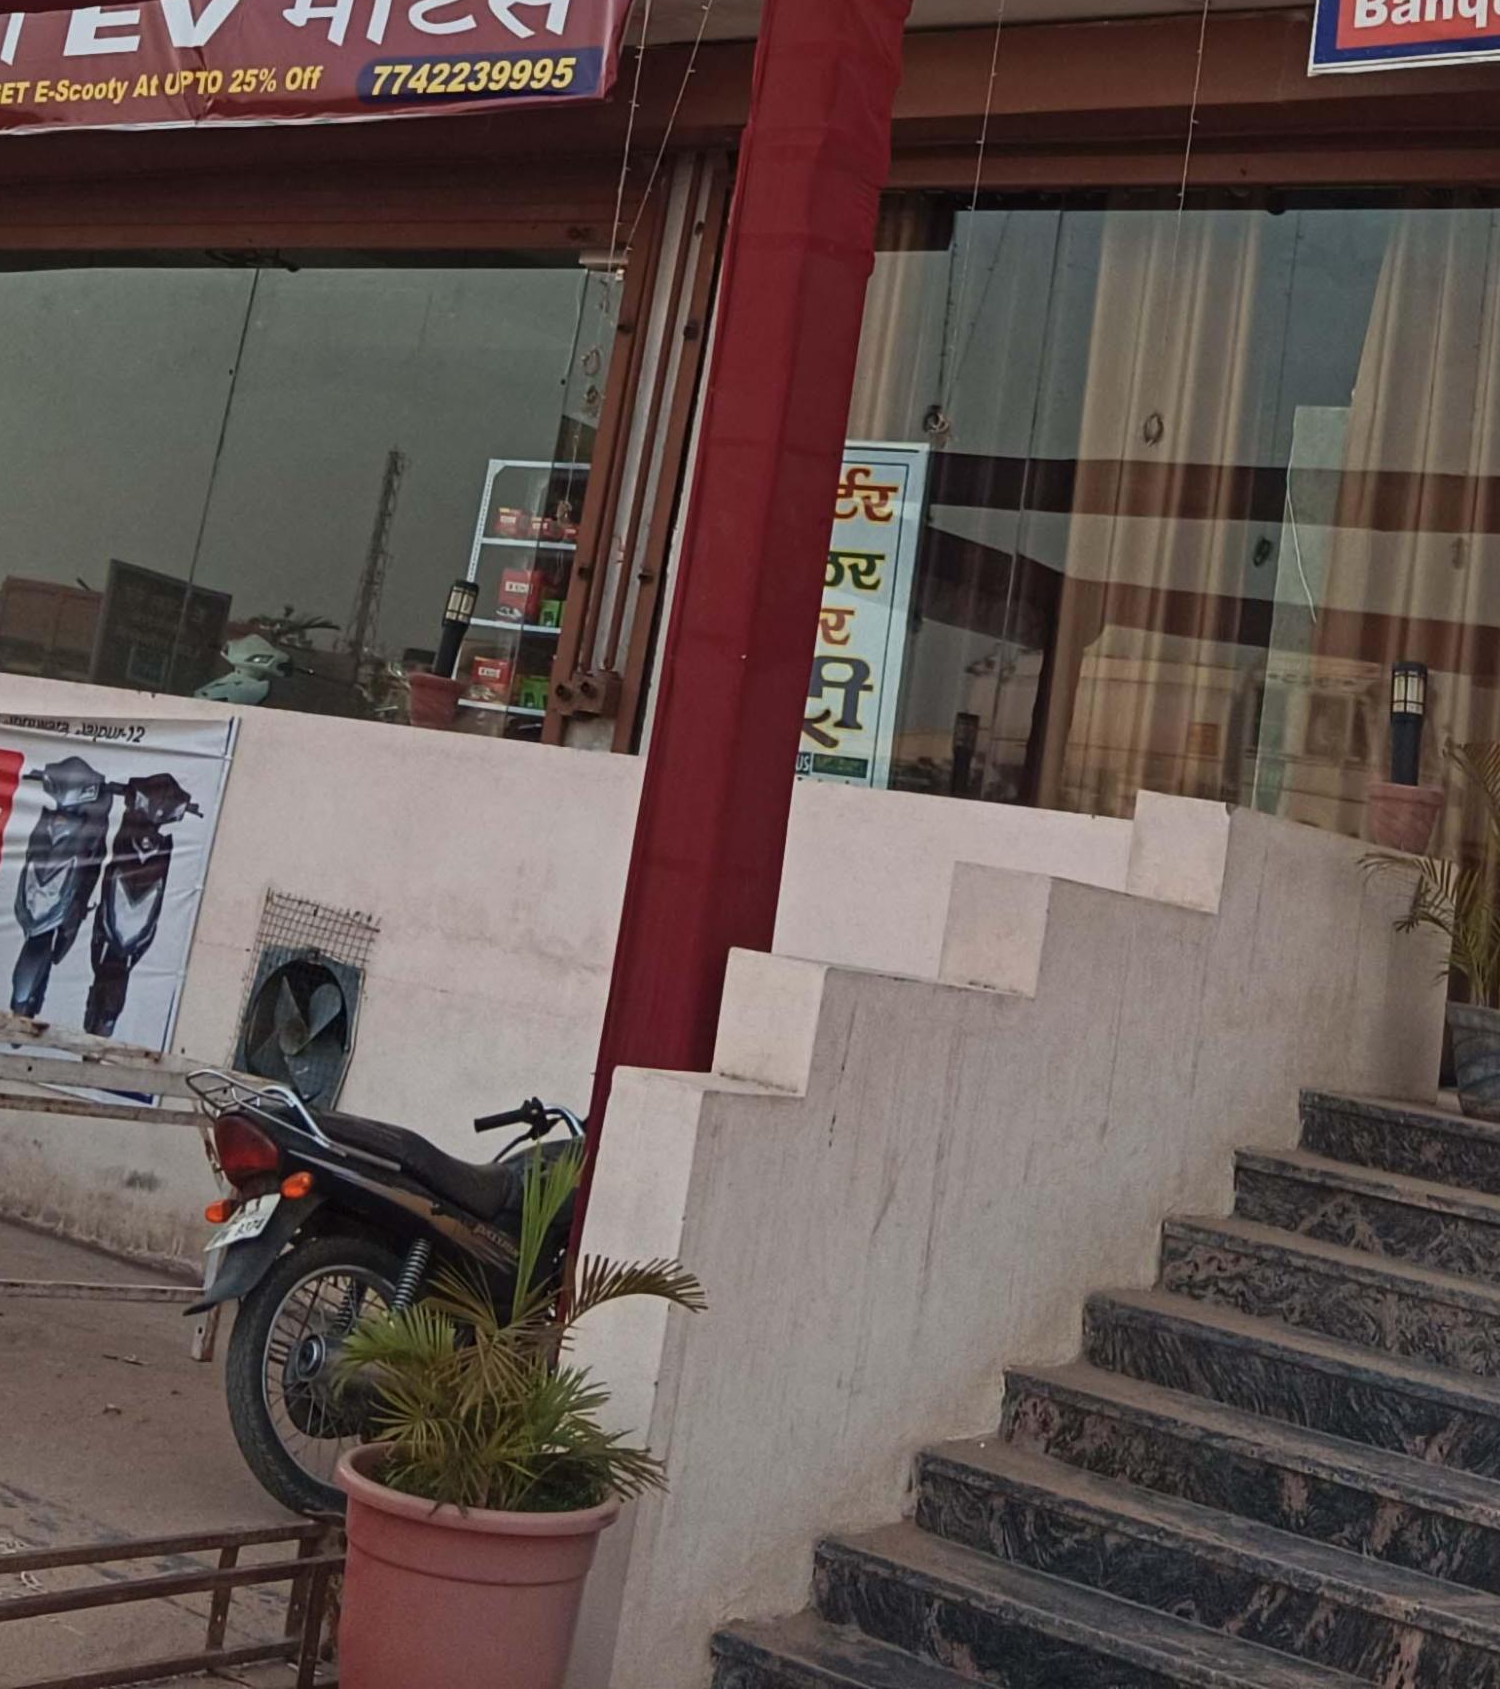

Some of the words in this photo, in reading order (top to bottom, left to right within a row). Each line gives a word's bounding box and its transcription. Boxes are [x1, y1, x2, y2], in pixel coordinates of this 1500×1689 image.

[33, 77, 129, 105] E-Scooty
[132, 74, 159, 98] At
[227, 67, 277, 94] 25%
[285, 65, 324, 90] Off
[371, 56, 577, 97] 7742239995
